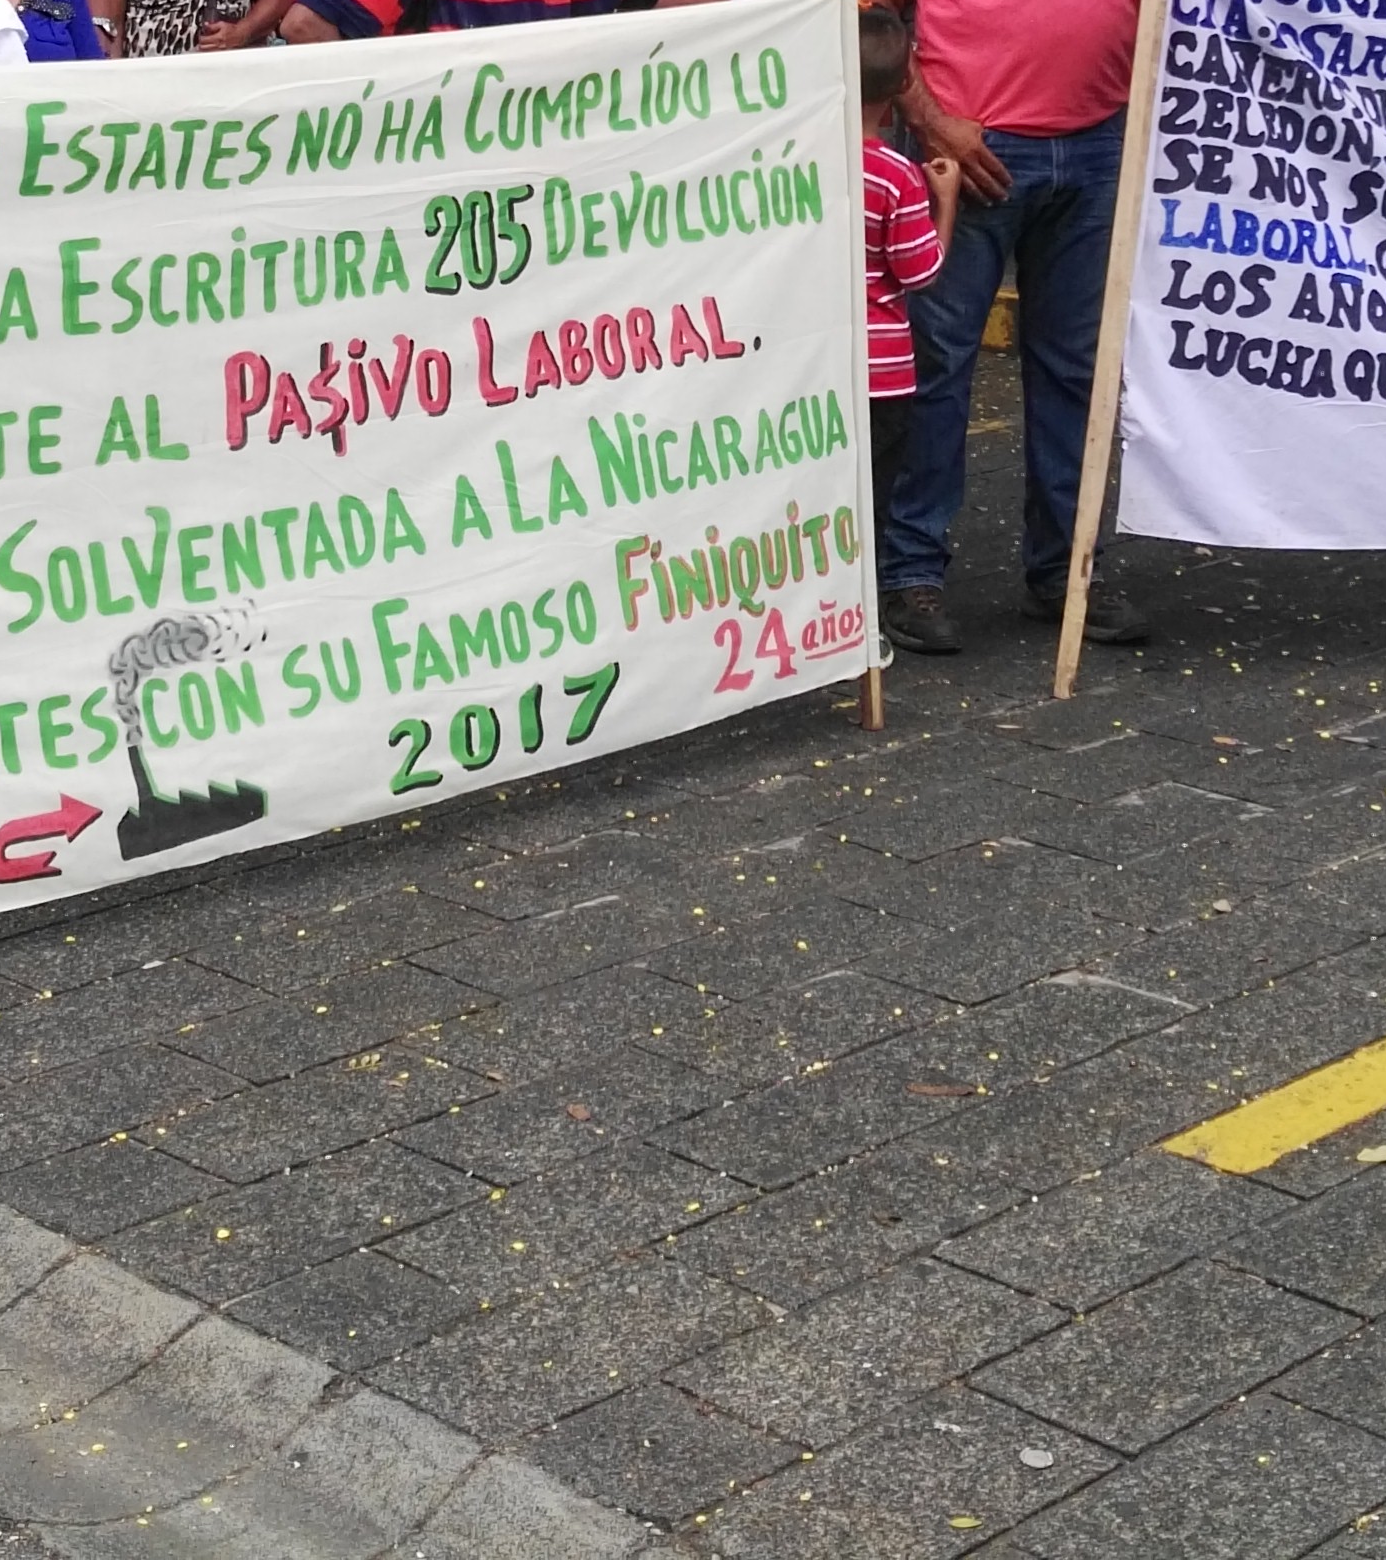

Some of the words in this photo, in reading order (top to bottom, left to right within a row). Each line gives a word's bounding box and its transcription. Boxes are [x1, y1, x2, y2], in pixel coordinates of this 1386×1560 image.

[20, 104, 275, 195] ESTATES
[733, 49, 784, 110] LO
[1153, 139, 1233, 194] SE
[1249, 153, 1328, 221] NOS
[425, 184, 534, 295] 205
[1161, 260, 1275, 318] LOS
[98, 397, 187, 463] AL
[474, 297, 761, 407] LABORAL.
[454, 478, 490, 543] A
[498, 444, 585, 530] LA
[143, 665, 261, 746] CON
[283, 642, 359, 714] SU
[373, 582, 595, 690] FAMOSO
[715, 609, 796, 692] 24
[801, 599, 864, 651] años
[389, 662, 620, 795] 2017
